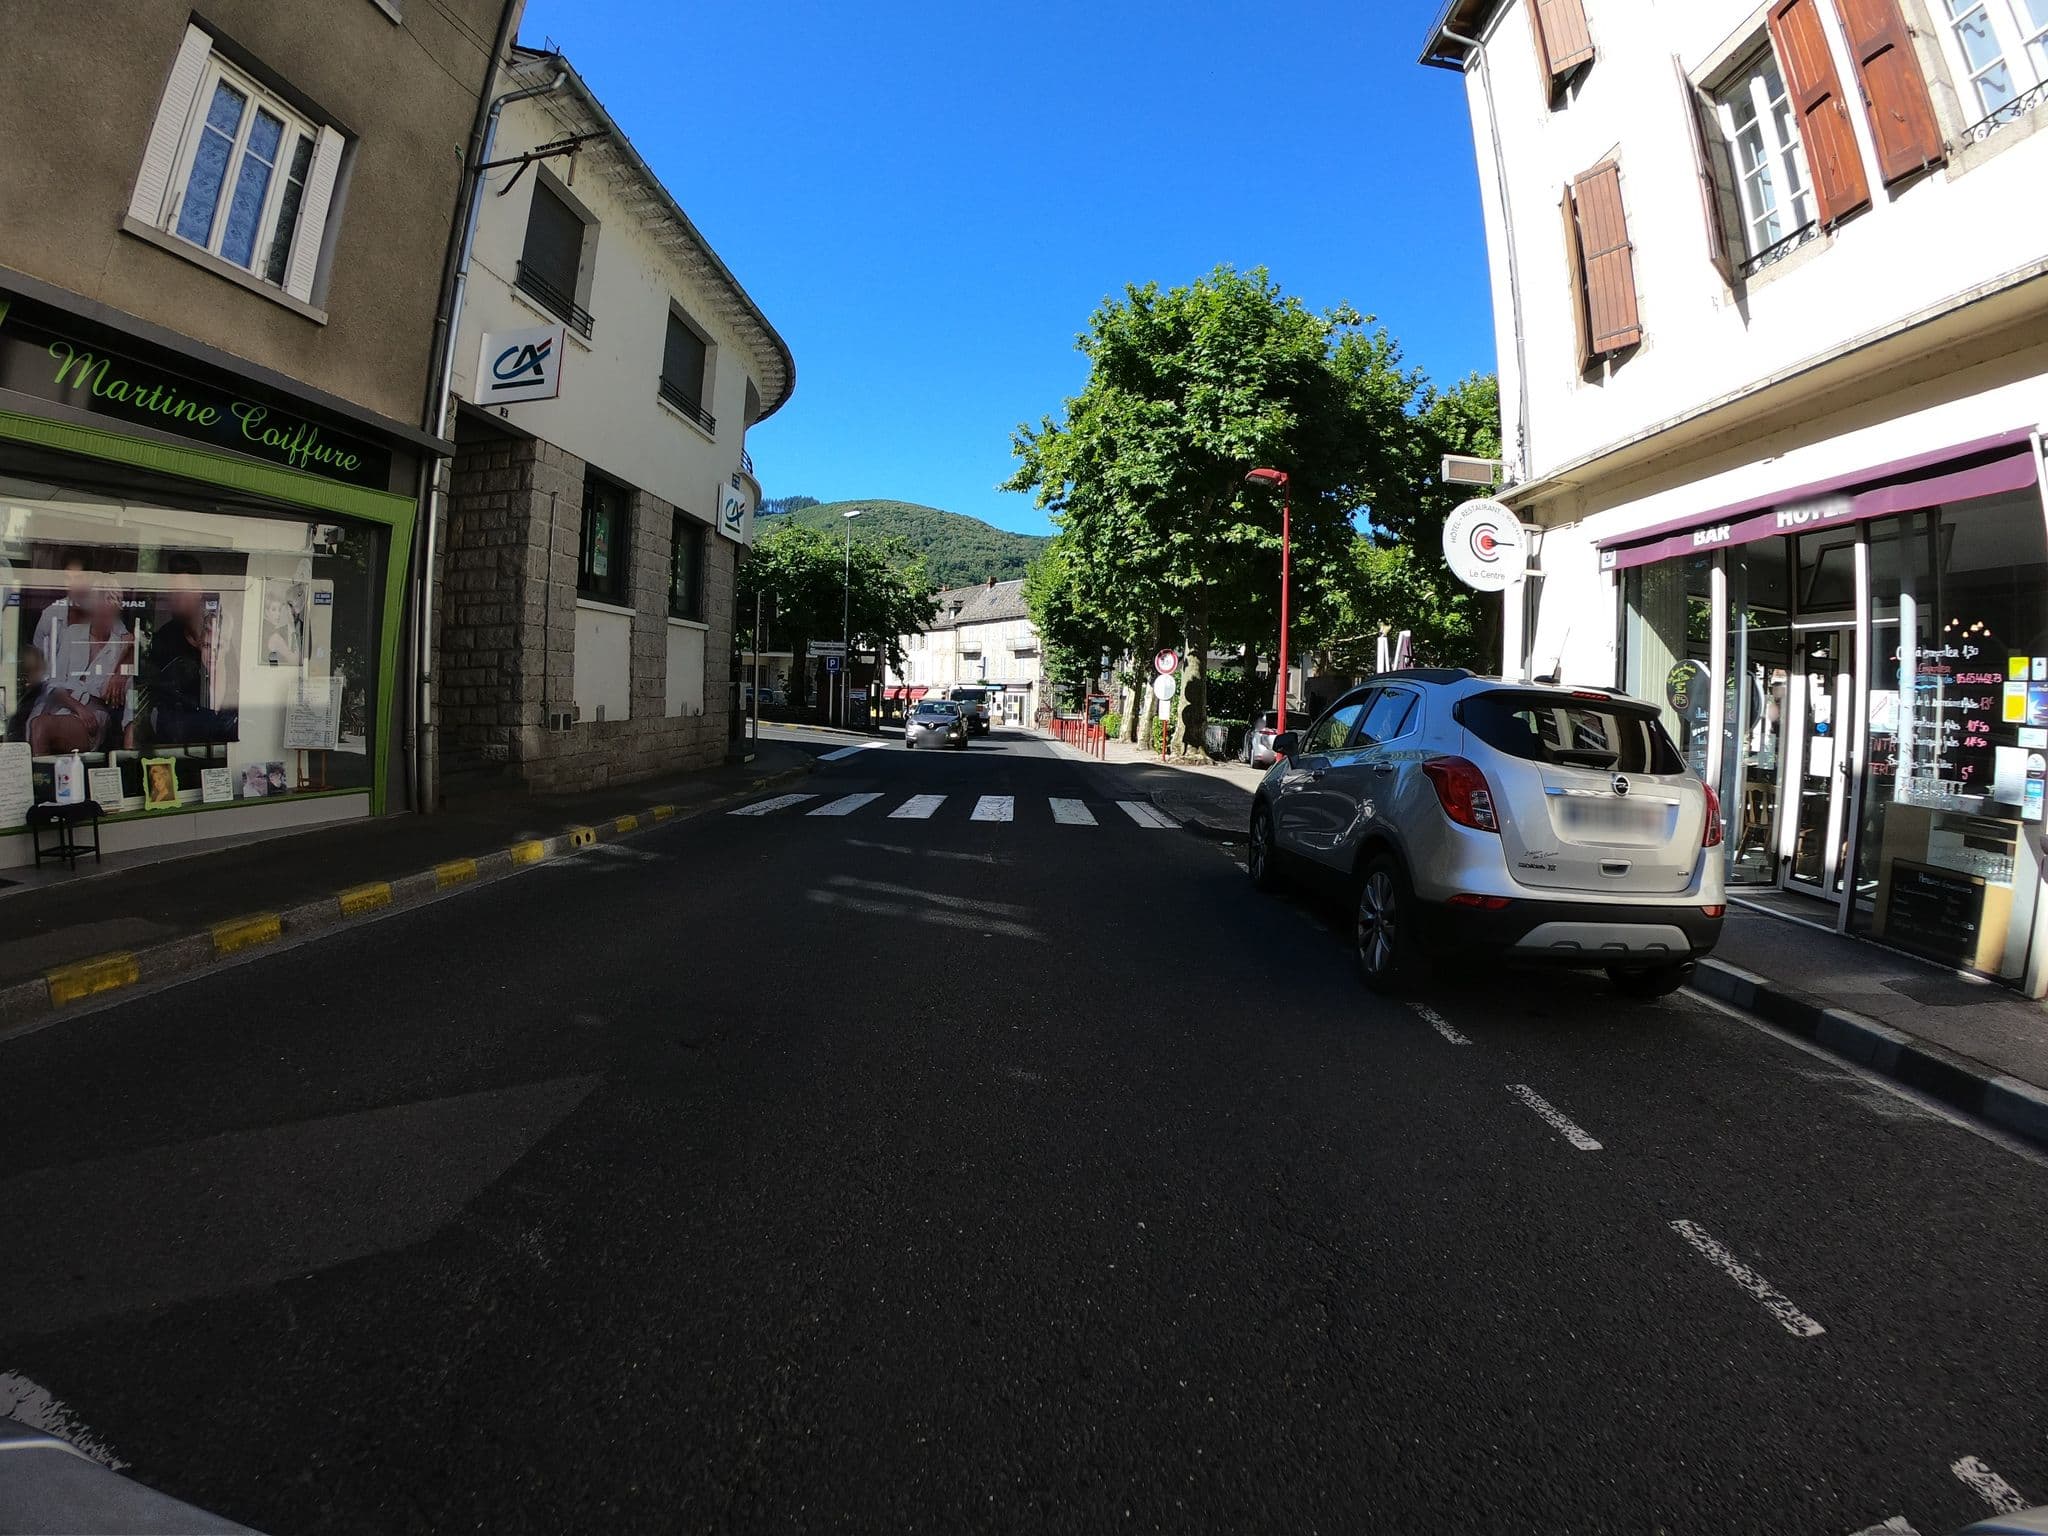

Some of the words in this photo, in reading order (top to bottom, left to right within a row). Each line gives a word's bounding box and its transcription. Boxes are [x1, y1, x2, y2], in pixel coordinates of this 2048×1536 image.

[48, 341, 222, 426] Martine
[230, 402, 361, 470] Coiffure
[1776, 501, 1852, 528] HOT
[1692, 524, 1731, 547] BAR
[1469, 568, 1479, 578] Le
[1480, 569, 1506, 581] Centre
